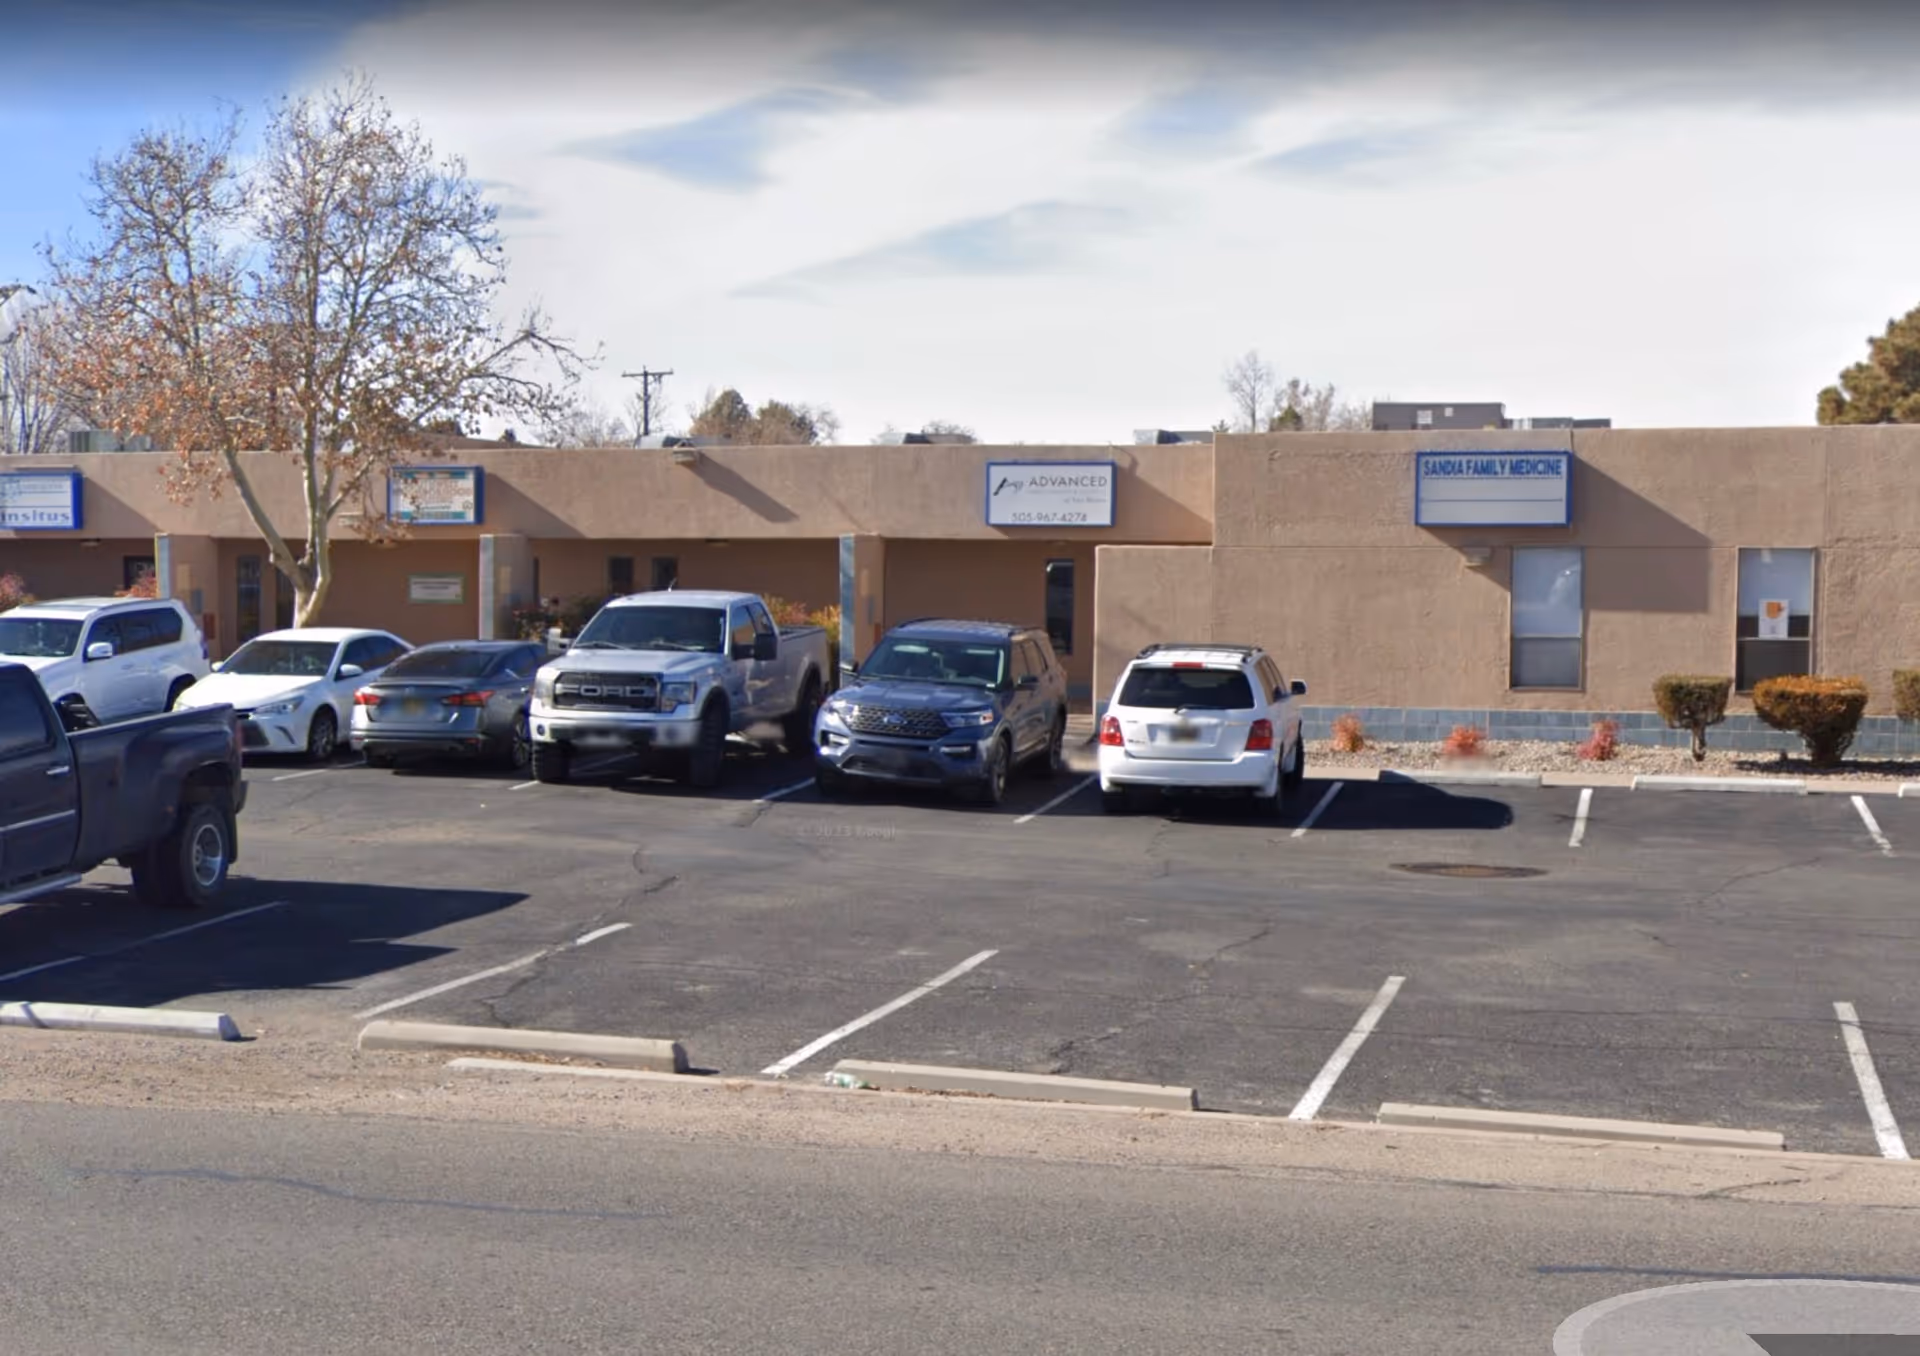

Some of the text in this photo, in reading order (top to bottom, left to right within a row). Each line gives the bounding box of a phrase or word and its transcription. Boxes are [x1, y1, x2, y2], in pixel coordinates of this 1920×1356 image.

[1423, 458, 1562, 476] SANDIA FAMILY MEDICINE
[1029, 476, 1107, 487] ADVANCED
[555, 684, 650, 697] FORD
